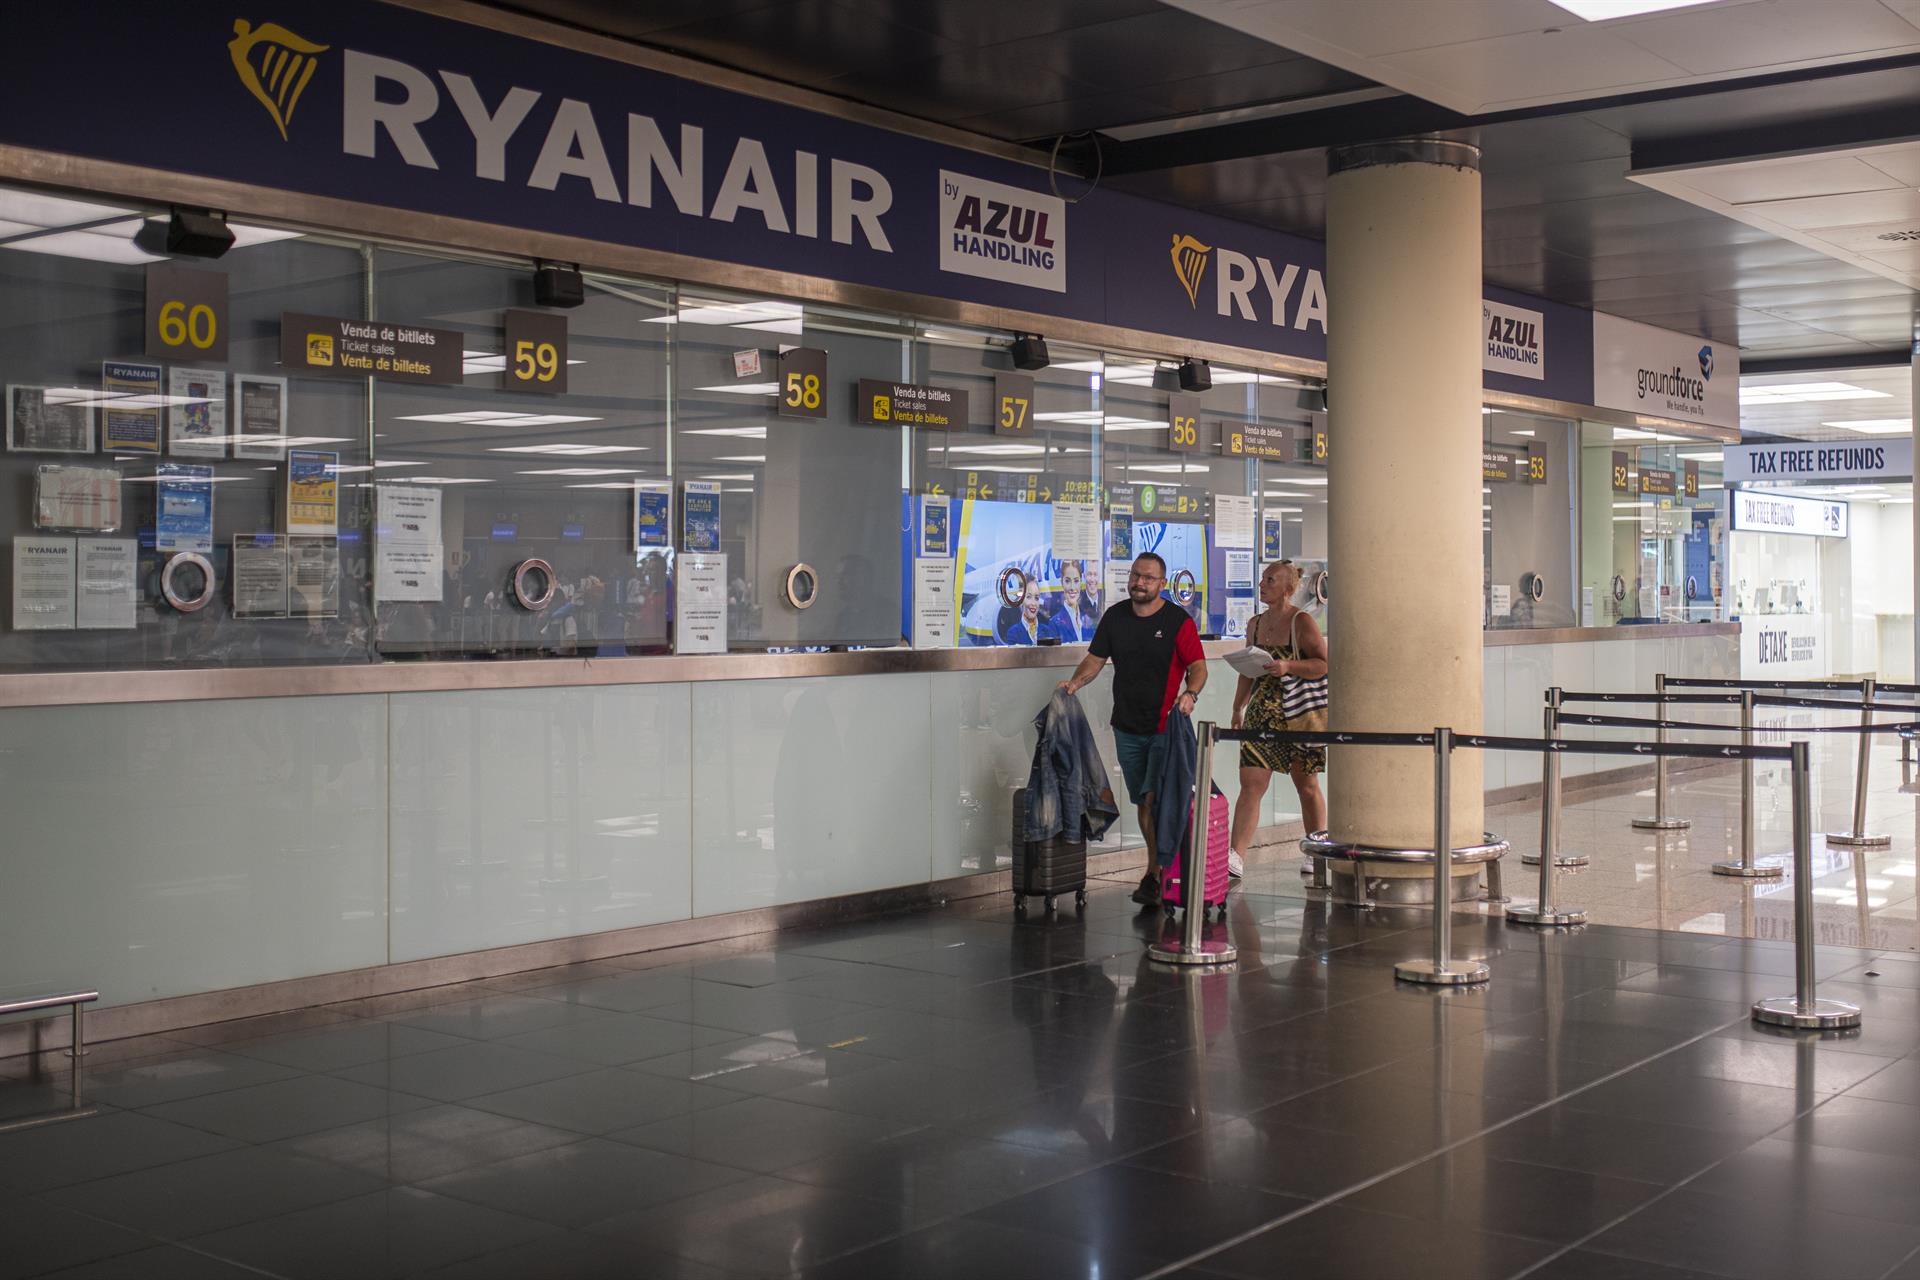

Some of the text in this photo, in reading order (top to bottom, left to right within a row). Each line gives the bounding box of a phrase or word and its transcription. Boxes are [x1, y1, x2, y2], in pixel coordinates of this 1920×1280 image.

[343, 48, 893, 253] RYANAIR
[944, 178, 959, 200] by
[954, 195, 1054, 249] AZUL
[953, 233, 1055, 270] HANDLING
[1483, 305, 1490, 320] by
[158, 300, 217, 350] 60
[340, 321, 436, 345] Venda de bitllets
[1488, 315, 1538, 349] AZUL
[341, 339, 395, 356] Ticket sales
[1488, 342, 1538, 364] HANDLING
[340, 352, 431, 375] Venta de billetes
[515, 341, 558, 382] 59
[113, 368, 157, 379] RYANAIR
[1638, 366, 1703, 401] groundforce
[786, 372, 820, 409] 58
[893, 385, 951, 402] Venda de bitllets
[894, 398, 926, 411] Ticket sales
[1001, 396, 1028, 429] 57
[893, 410, 948, 424] Venta de billetes
[1174, 416, 1196, 446] 56
[1244, 425, 1260, 435] Venda
[1260, 427, 1266, 436] de
[1244, 444, 1258, 454] Venta
[1259, 446, 1264, 455] de
[1316, 433, 1328, 458] 5
[1530, 456, 1544, 479] 53
[1749, 447, 1885, 473] TAX FREE REFUNDS
[1614, 466, 1626, 487] 52
[1686, 474, 1697, 493] 51
[1745, 500, 1795, 527] TAX FREE REFUNDS
[28, 546, 68, 555] RYANAIR
[1759, 624, 1787, 664] DÉTAXE
